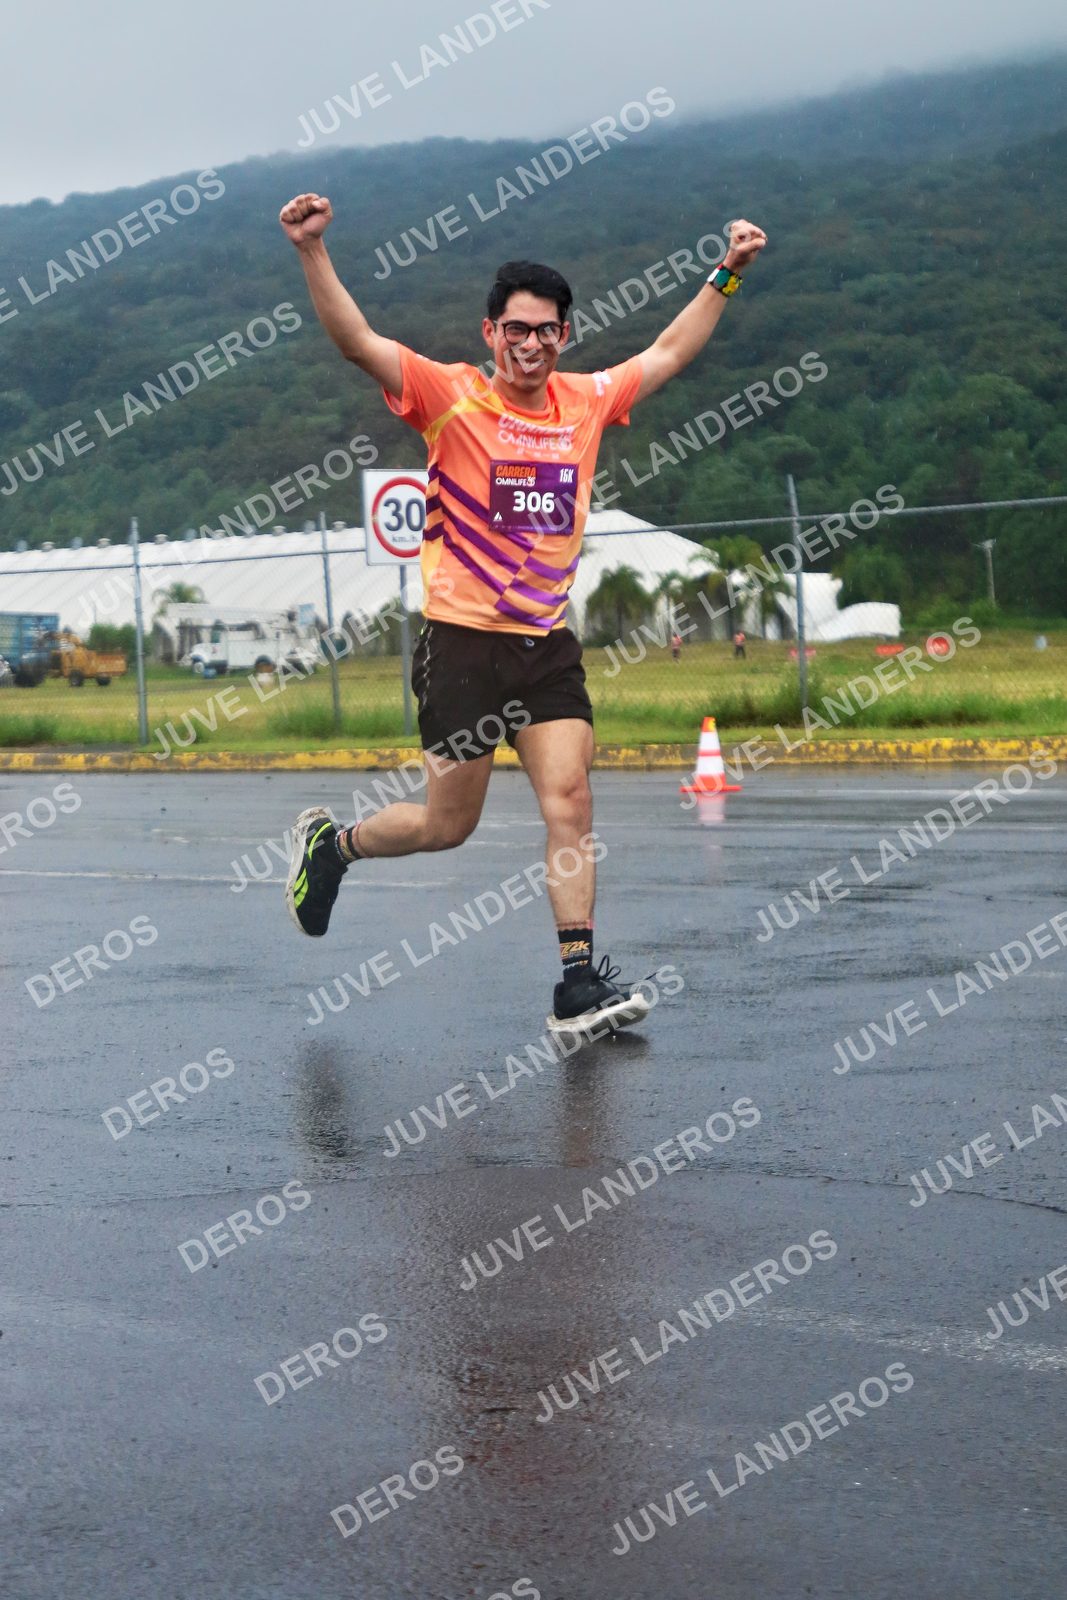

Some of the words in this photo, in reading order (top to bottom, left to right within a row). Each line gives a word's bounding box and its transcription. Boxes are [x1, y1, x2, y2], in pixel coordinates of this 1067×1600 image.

[496, 465, 536, 478] CARRERA
[496, 477, 527, 486] OMNILIFE
[513, 491, 554, 513] 306
[384, 497, 426, 532] 30
